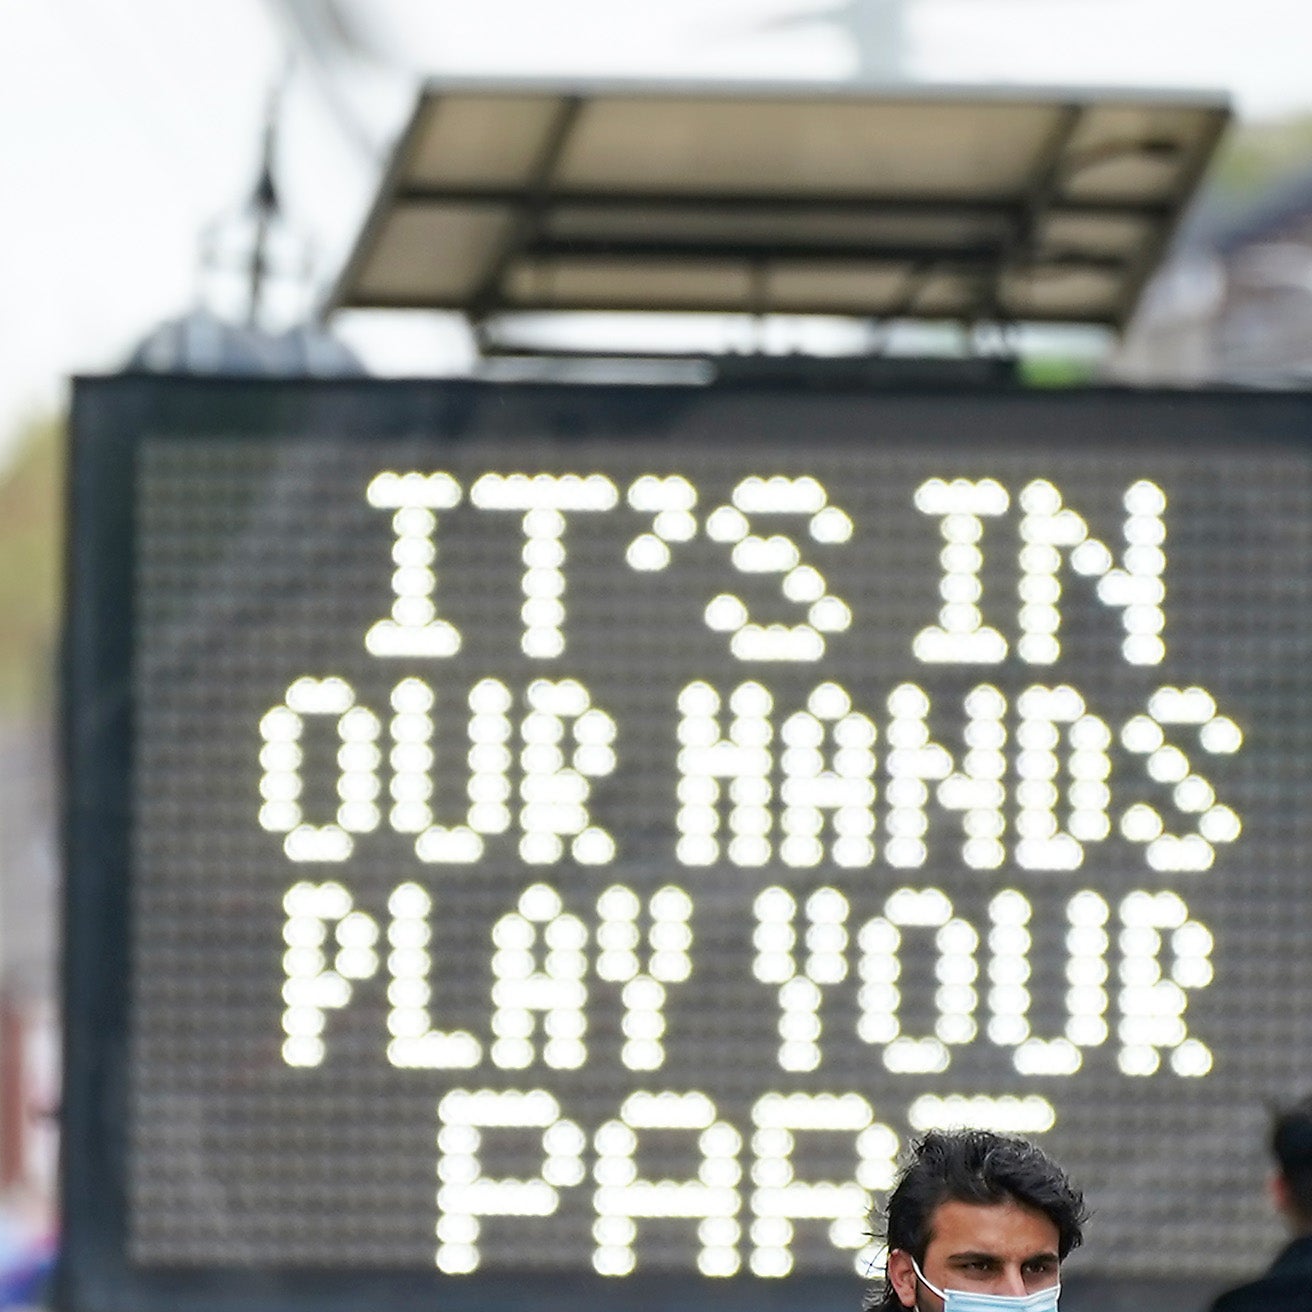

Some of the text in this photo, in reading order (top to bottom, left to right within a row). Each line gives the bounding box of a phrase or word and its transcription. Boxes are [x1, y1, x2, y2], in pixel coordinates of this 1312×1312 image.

[364, 470, 1167, 666] IT'S IN
[257, 675, 1243, 873] OUR HANDS
[279, 881, 1214, 1078] PLAY YOUR
